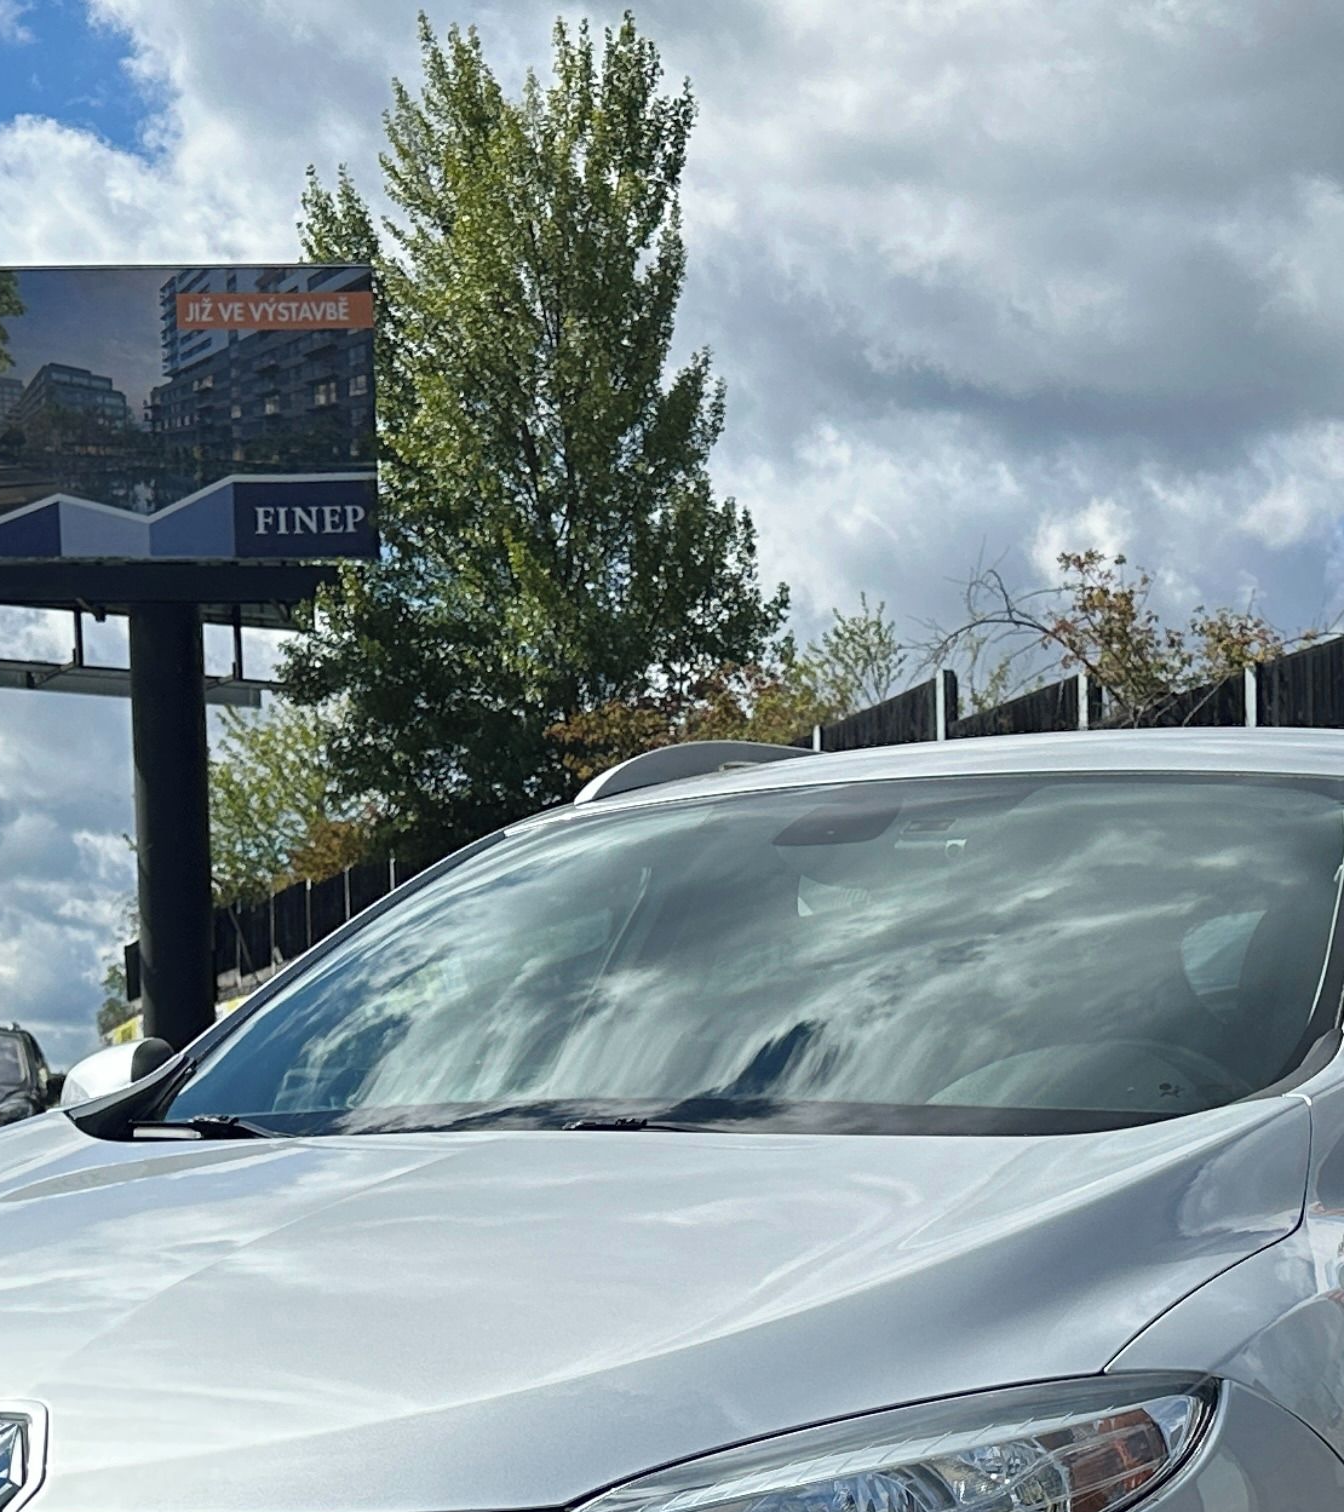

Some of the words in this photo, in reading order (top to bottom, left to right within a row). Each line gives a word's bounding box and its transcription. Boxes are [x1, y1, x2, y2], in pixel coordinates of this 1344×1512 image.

[185, 298, 213, 322] JIŽ
[218, 302, 244, 321] VE
[250, 297, 350, 321] VÝSTAVBĚ
[254, 505, 365, 535] FINEP
